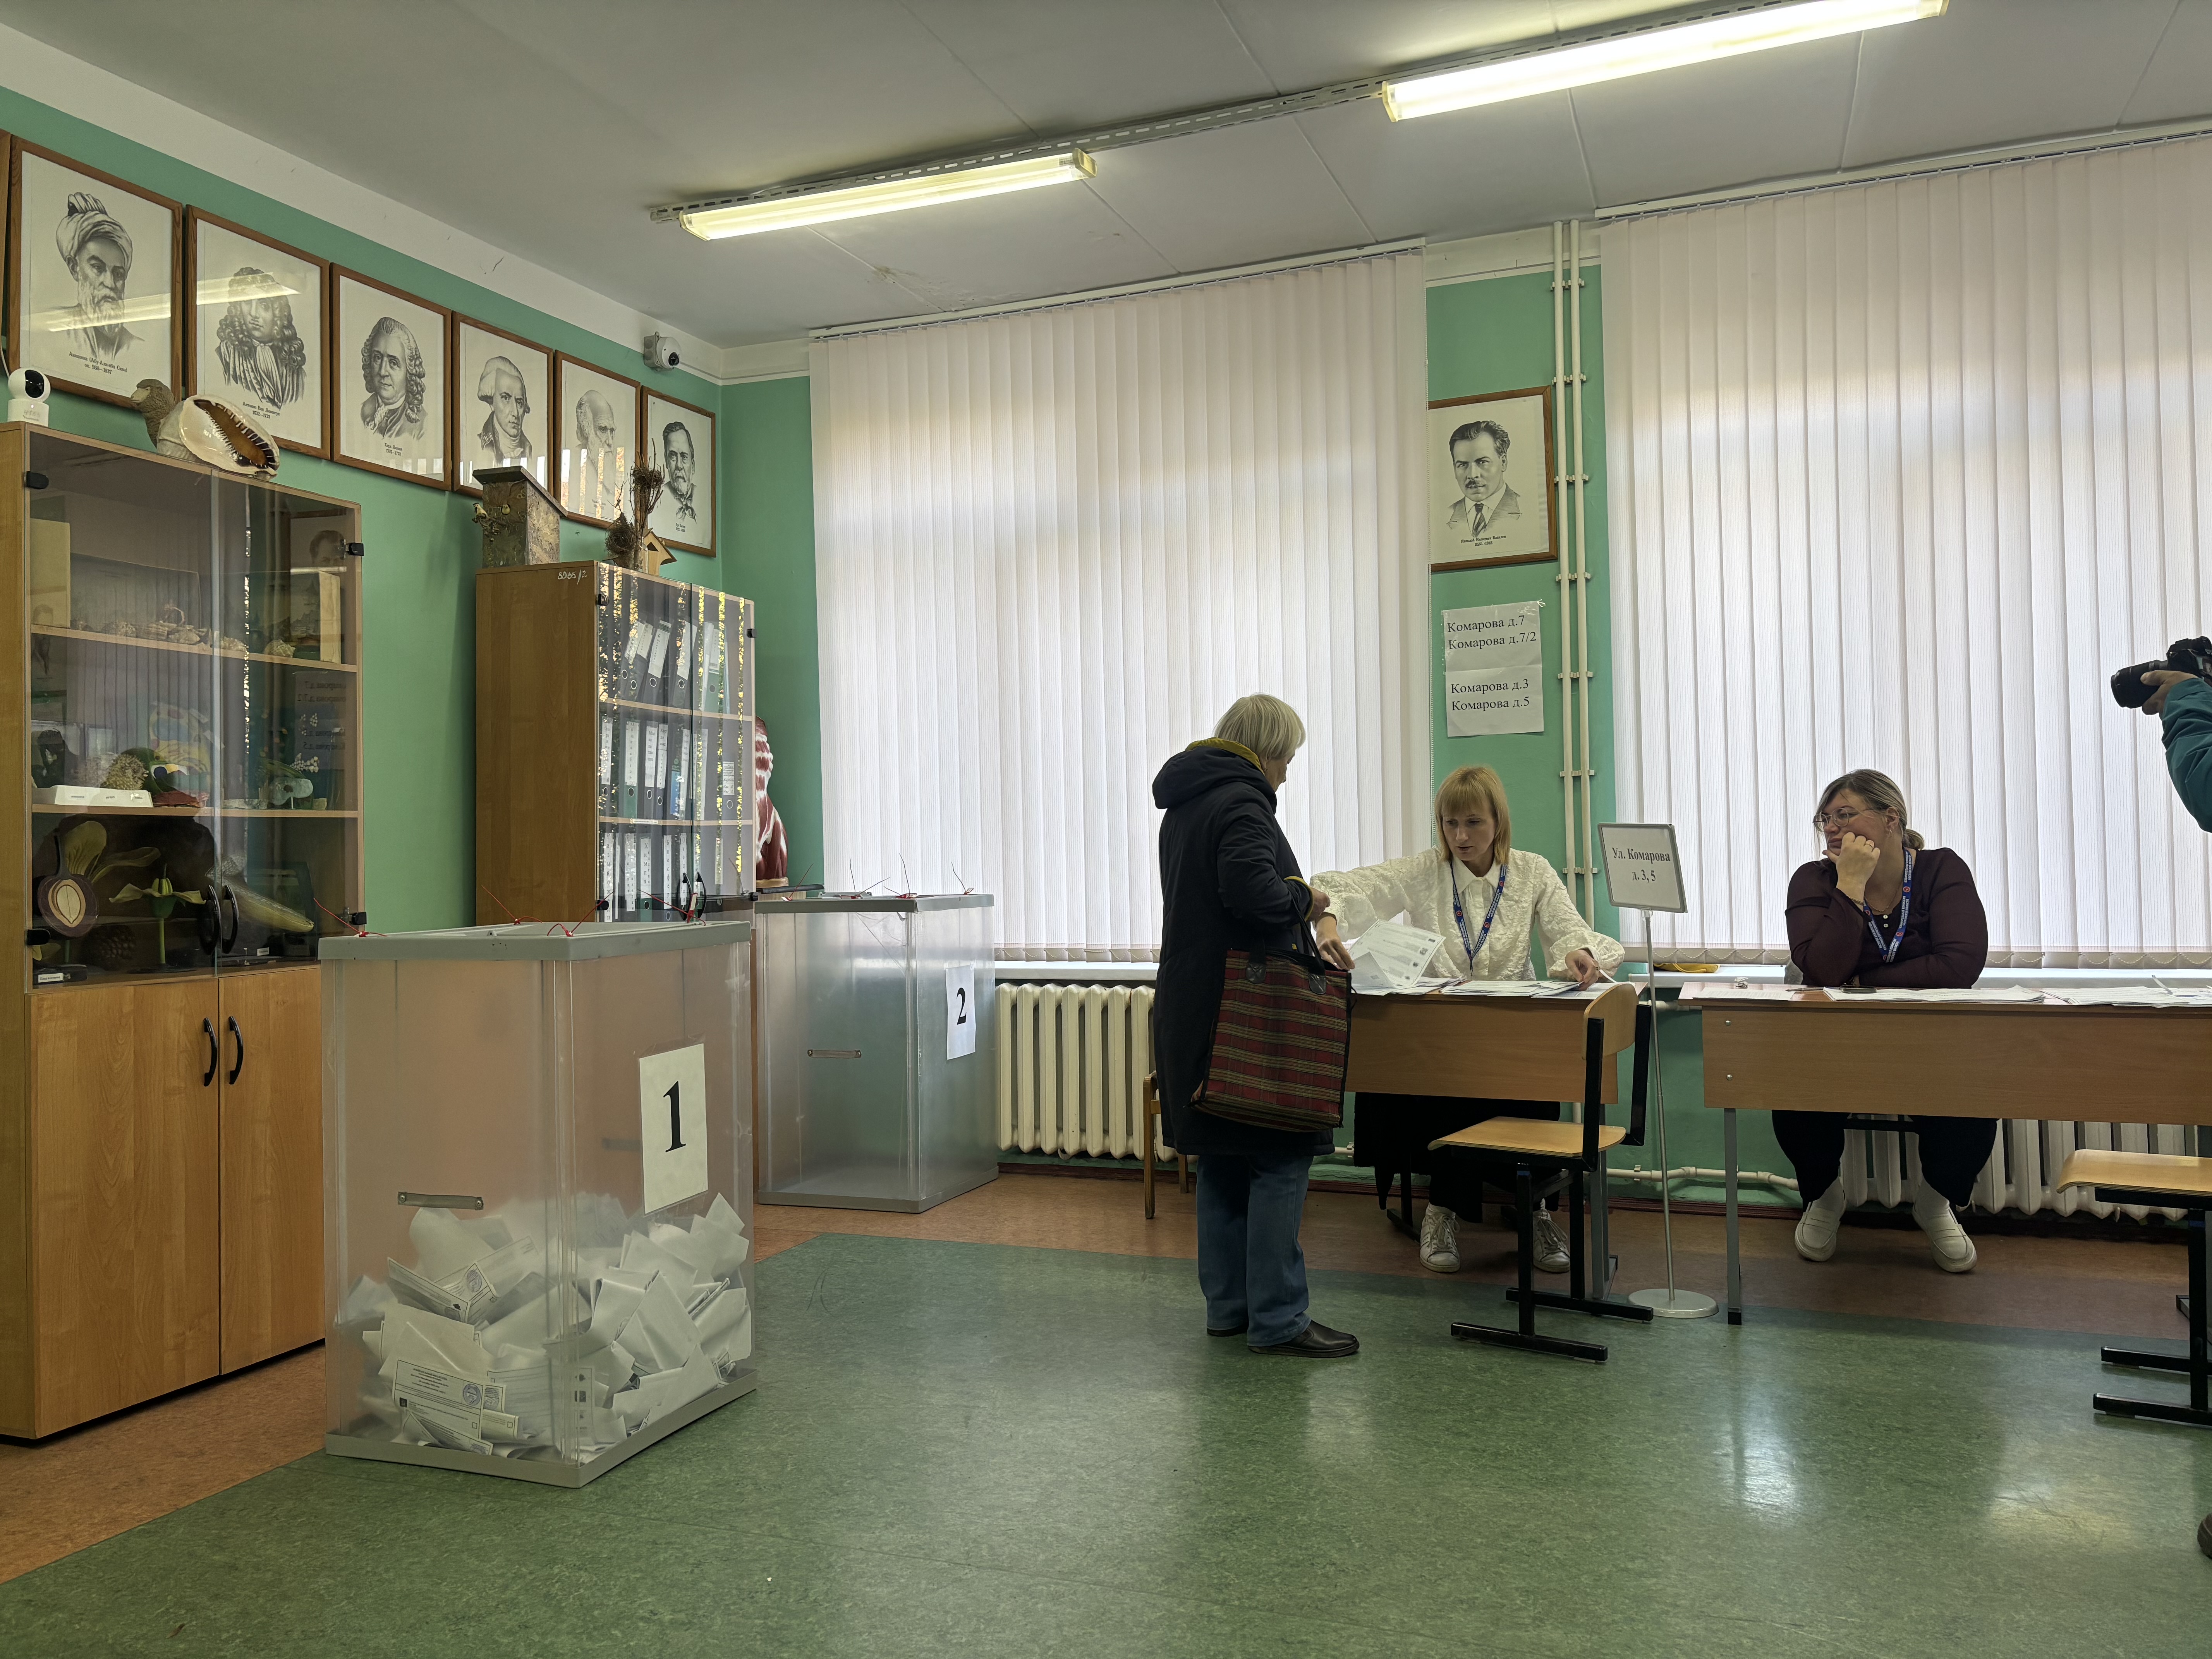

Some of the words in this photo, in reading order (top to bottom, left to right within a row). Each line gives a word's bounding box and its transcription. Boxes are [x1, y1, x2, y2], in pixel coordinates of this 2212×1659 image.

[1447, 620, 1504, 632] Комарова
[1508, 615, 1525, 627] д.7
[1448, 637, 1505, 649] Комарова
[1508, 631, 1537, 645] д.7/2
[1451, 683, 1509, 694] Комарова
[1512, 678, 1529, 691] д.3
[1452, 700, 1509, 711] Комарова
[1512, 696, 1530, 708] д.5
[1612, 847, 1626, 859] Ул.
[1627, 848, 1671, 864] Комарова
[1632, 872, 1640, 881] д.
[1641, 869, 1649, 883] 3,
[1650, 870, 1656, 881] 5
[956, 988, 967, 1025] 2
[663, 1080, 686, 1152] 1
